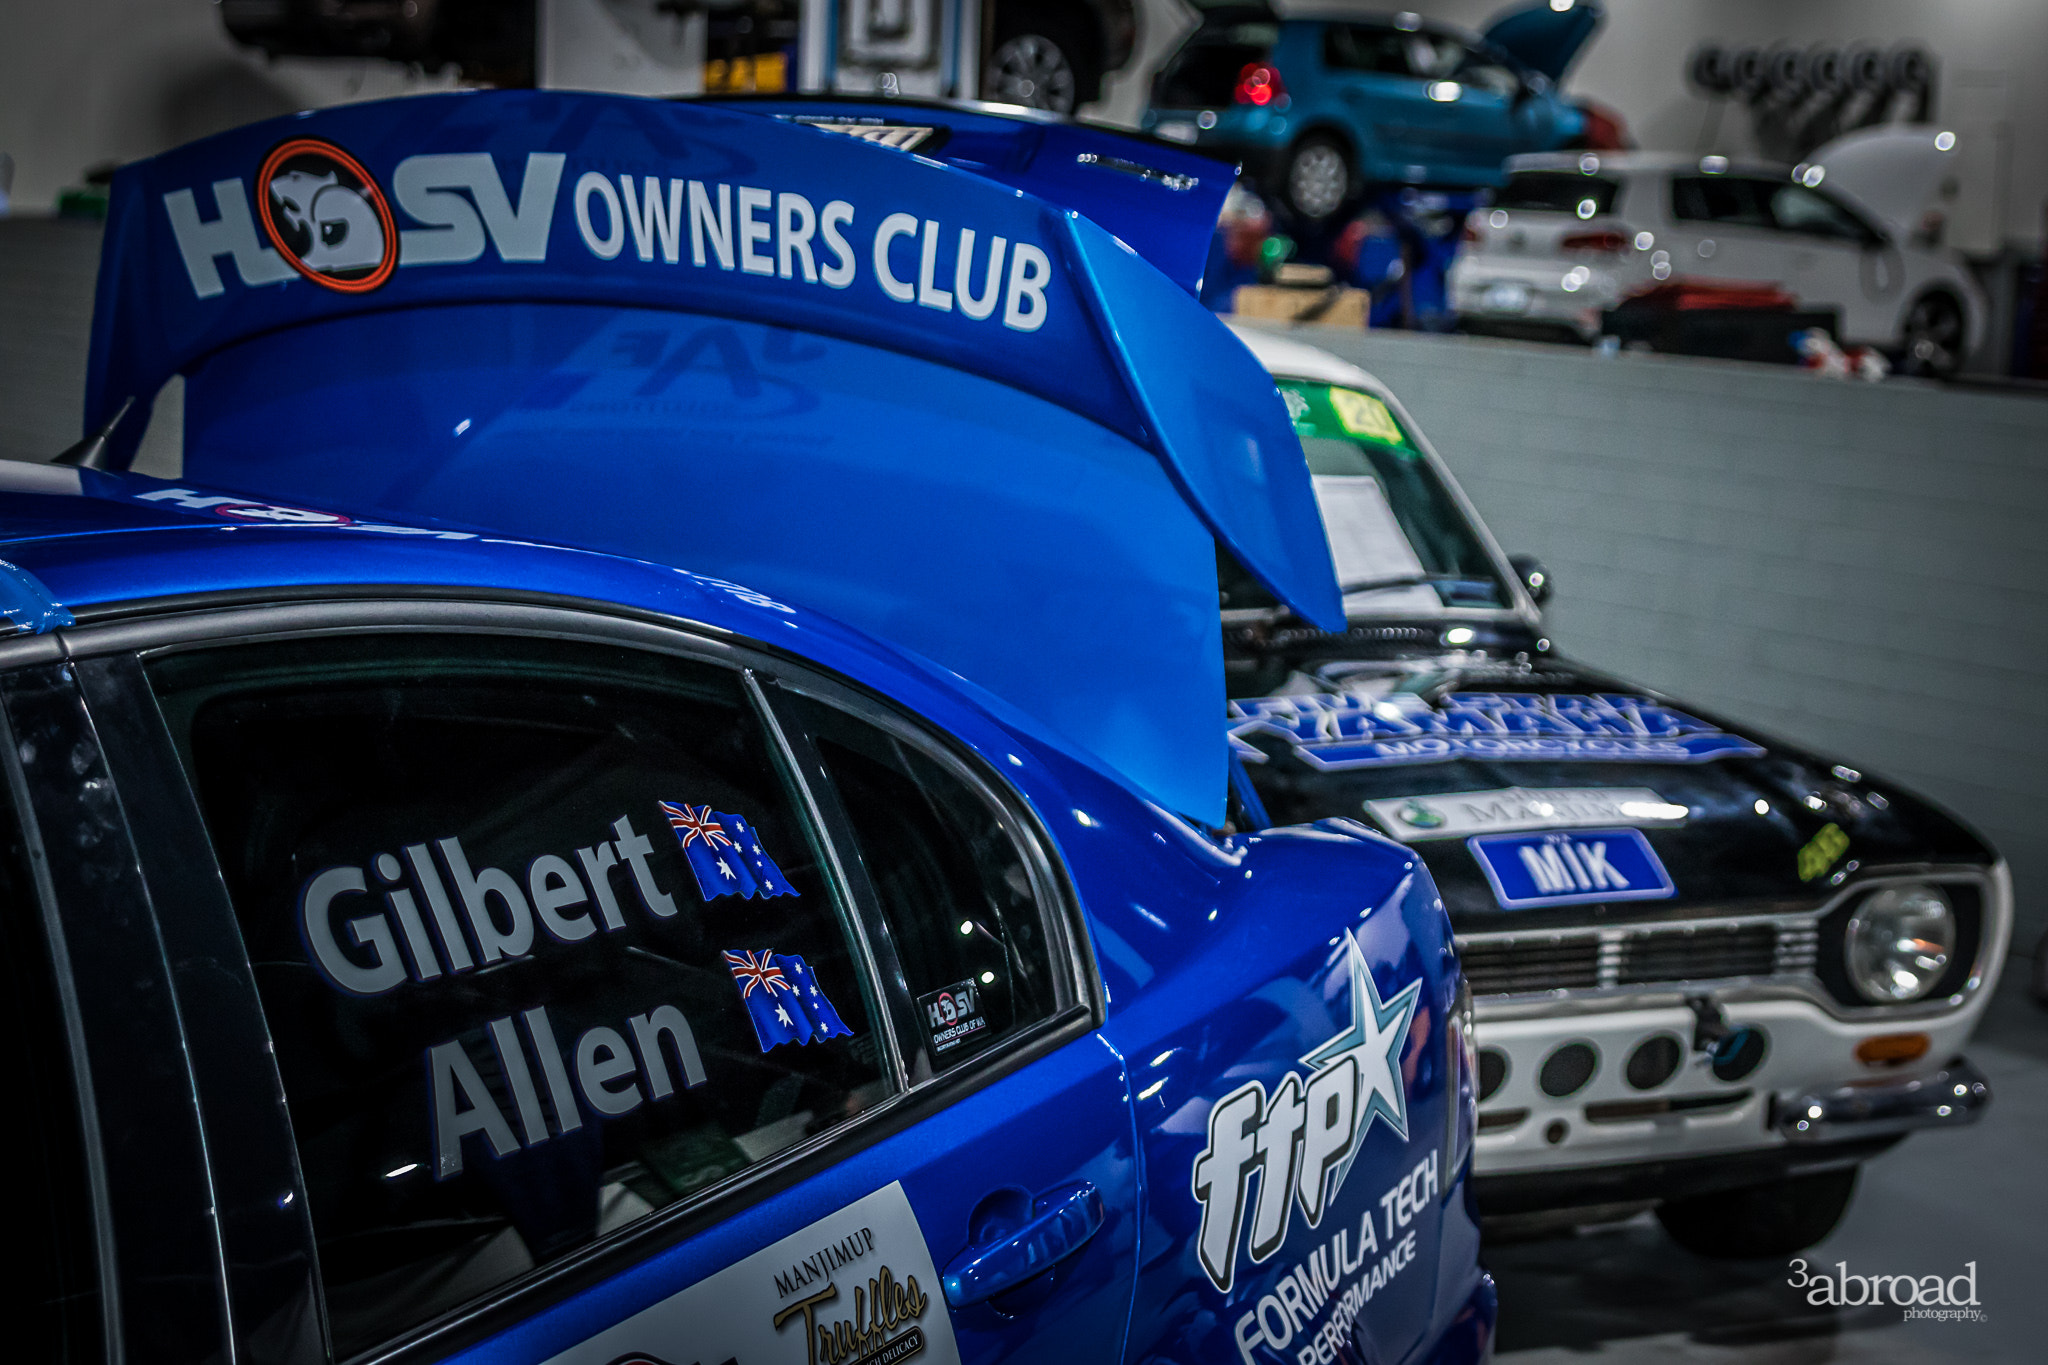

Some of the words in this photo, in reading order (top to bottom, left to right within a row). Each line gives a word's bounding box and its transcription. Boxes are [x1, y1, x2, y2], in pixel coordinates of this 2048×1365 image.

[574, 172, 856, 289] OWNERS
[872, 213, 1051, 333] CLUB
[304, 814, 678, 994] Gilbert
[1518, 841, 1630, 895] MIK
[429, 1005, 708, 1178] Allen
[933, 1027, 957, 1044] OWNERS
[955, 1022, 970, 1035] CLUB
[969, 1019, 977, 1030] OF
[1193, 1054, 1363, 1293] ftp
[773, 1226, 876, 1299] MANJIMUP
[773, 1265, 928, 1365] Truffles
[1235, 1210, 1379, 1365] FORMULA
[1381, 1149, 1439, 1241] TECH
[1297, 1229, 1417, 1365] PERFORMANCE
[882, 1333, 920, 1362] DELICACY
